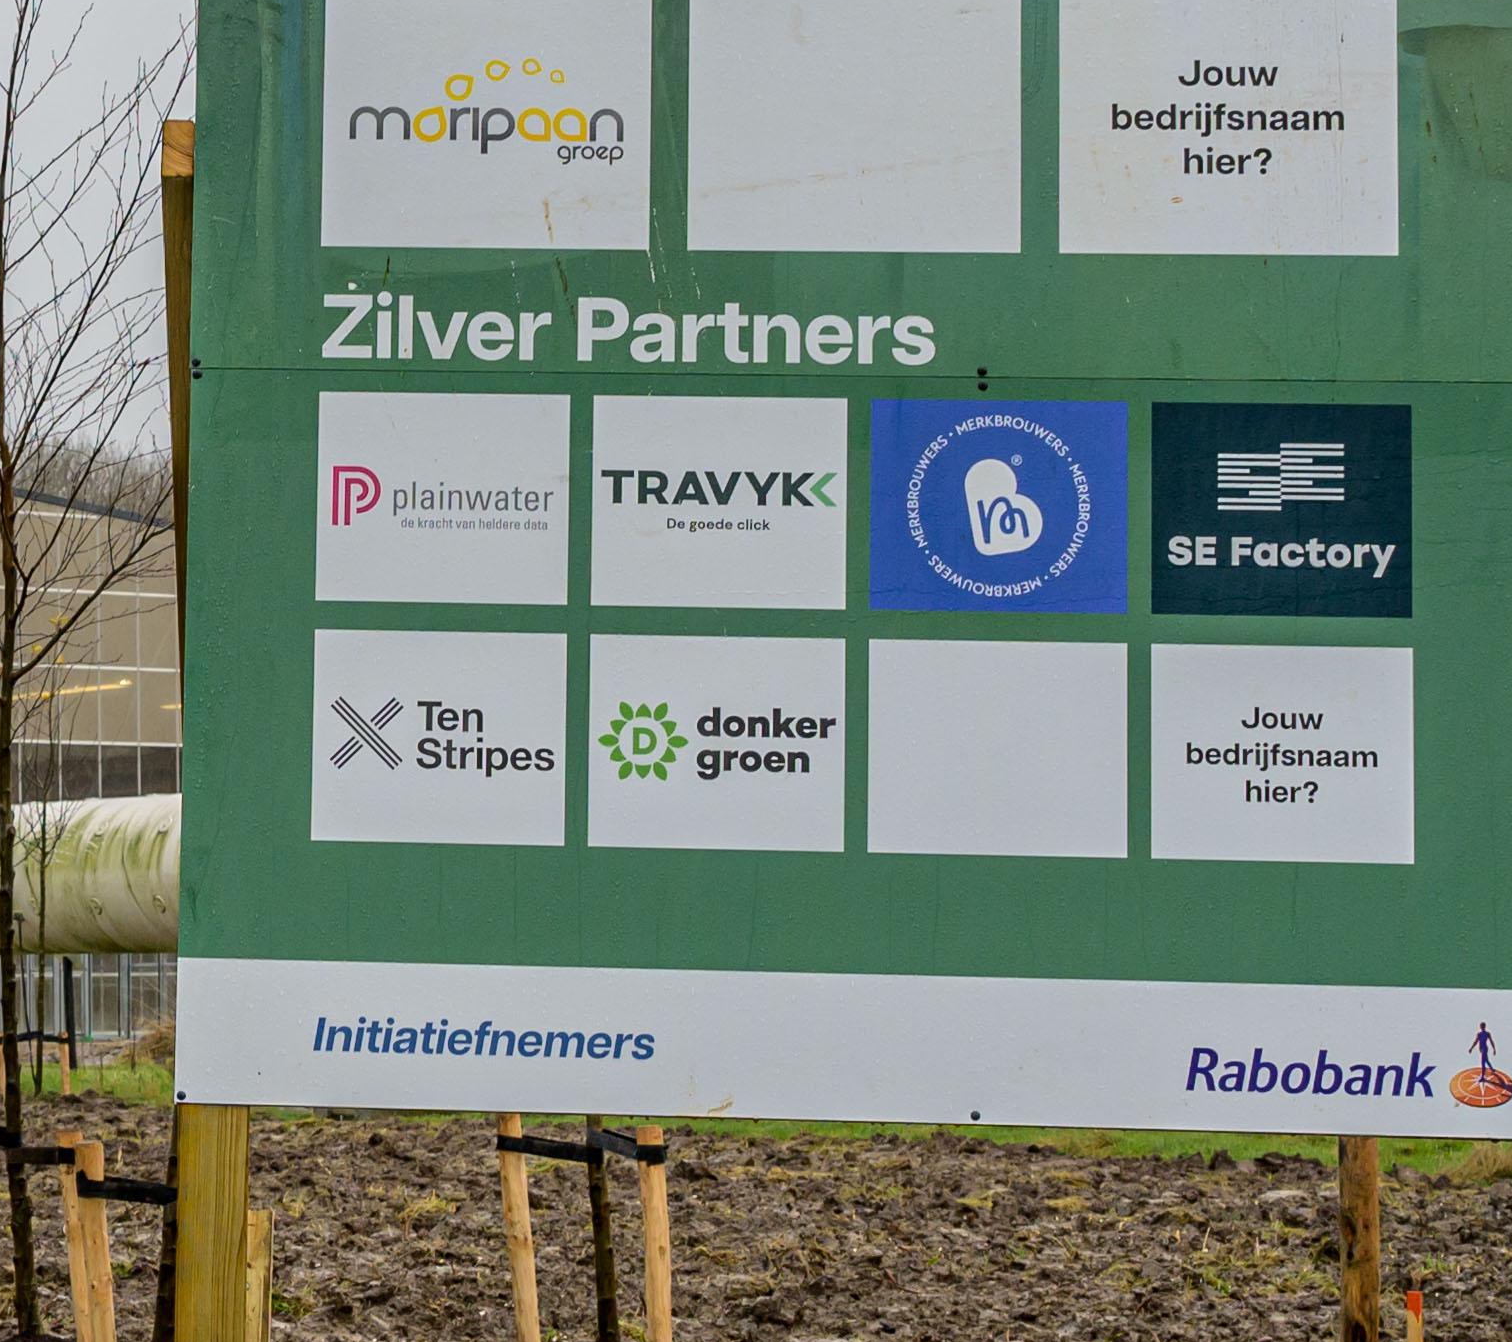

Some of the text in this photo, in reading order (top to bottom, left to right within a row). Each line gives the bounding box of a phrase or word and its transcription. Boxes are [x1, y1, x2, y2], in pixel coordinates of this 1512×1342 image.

[1177, 58, 1278, 91] Jouw
[348, 103, 624, 156] maripaan
[1109, 100, 1346, 139] bedrijfsnaam
[556, 142, 624, 167] groep
[1180, 143, 1274, 179] hier?
[321, 293, 936, 367] Zilver Partners
[955, 415, 1069, 458] MERKBROUWERS
[392, 481, 554, 516] plainwater
[907, 435, 949, 548] MERKBROUWERS
[401, 517, 414, 529] de
[417, 517, 453, 529] kracht
[456, 518, 476, 529] van
[524, 518, 548, 531] data
[666, 517, 770, 534] De goede click
[1049, 463, 1091, 578] MERKBROUWERS
[1167, 535, 1396, 578] SE Factory
[928, 554, 1043, 597] MERKBROUWERS
[417, 701, 483, 733] Ten
[696, 706, 837, 739] donker
[1241, 707, 1324, 731] Jouw
[416, 738, 555, 777] Stripes
[696, 748, 811, 780] groen
[1185, 742, 1379, 772] bedrijfsnaam
[1244, 780, 1319, 804] hier?
[312, 1016, 656, 1061] Initiatiefnemers
[1185, 1046, 1436, 1100] Rabobank
